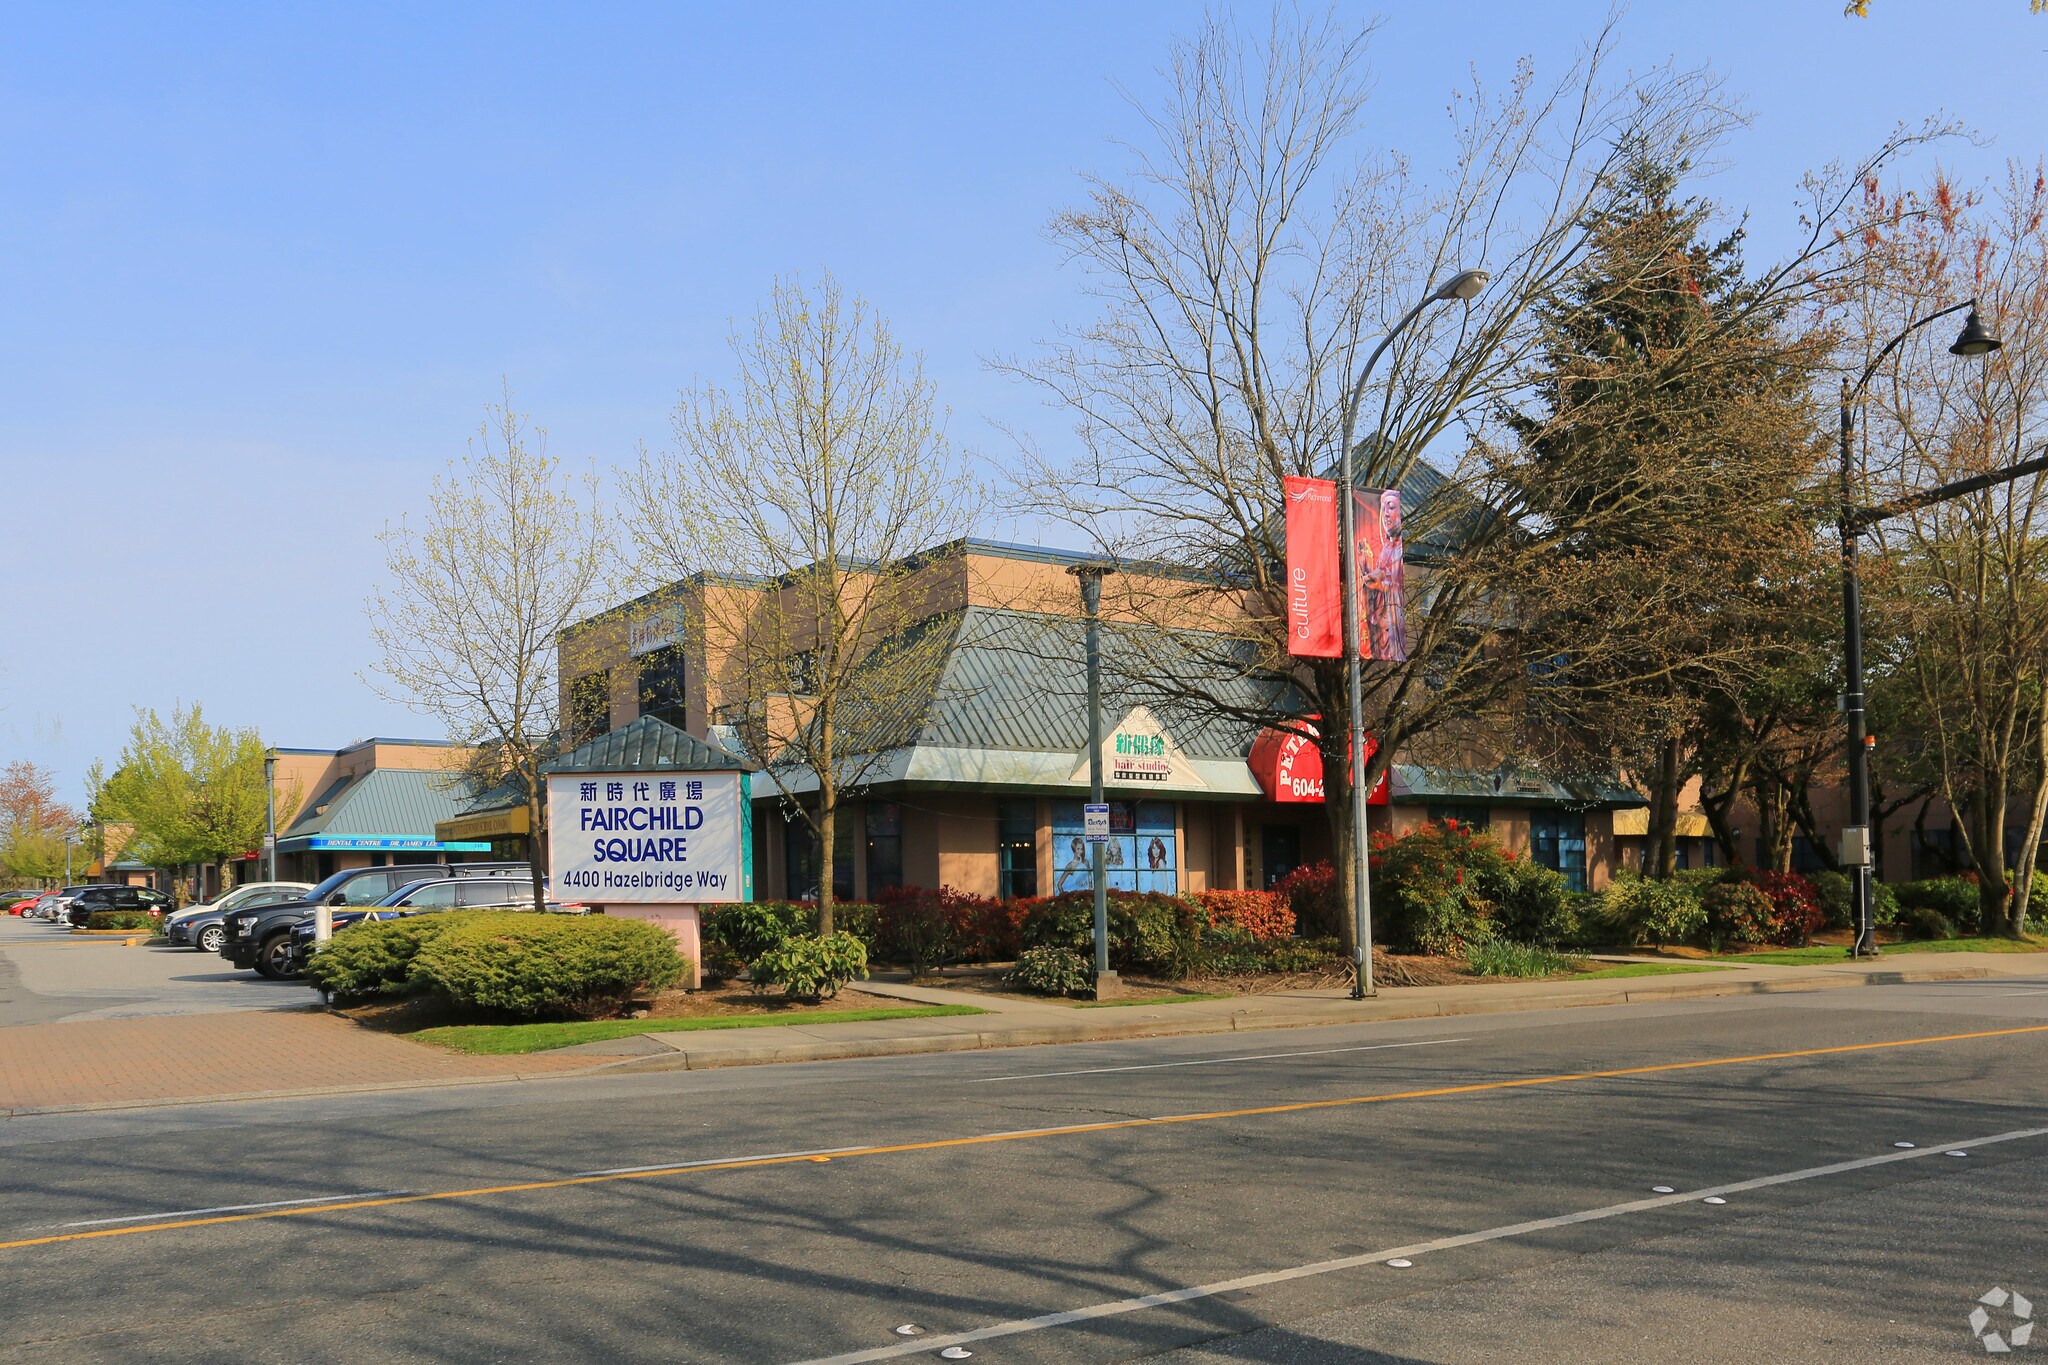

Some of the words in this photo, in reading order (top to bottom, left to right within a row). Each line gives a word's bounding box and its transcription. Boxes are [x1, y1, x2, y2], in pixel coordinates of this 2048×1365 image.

[1307, 493, 1332, 502] Richmond
[1292, 567, 1310, 639] culture
[1115, 759, 1134, 770] hair
[1138, 760, 1167, 771] studio
[580, 781, 703, 802] 新時代廣場
[581, 806, 704, 831] FAIRCHILD
[593, 838, 687, 862] SQUARE
[563, 871, 600, 888] 4400
[604, 871, 693, 892] Hazelbridge
[697, 871, 728, 891] Way
